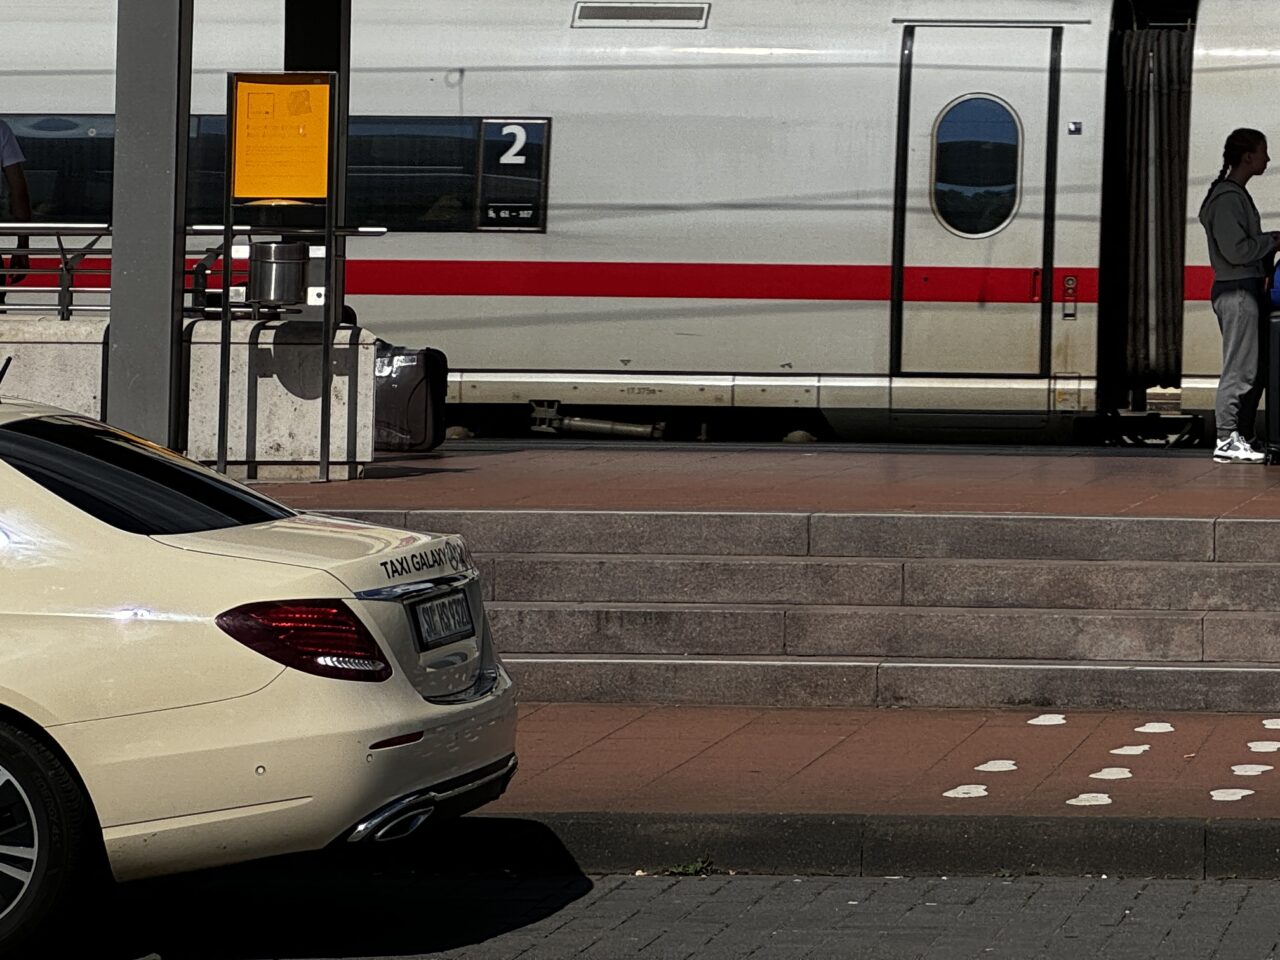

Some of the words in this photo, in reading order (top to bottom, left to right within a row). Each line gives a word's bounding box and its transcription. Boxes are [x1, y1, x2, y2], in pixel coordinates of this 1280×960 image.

[499, 124, 527, 164] 2
[380, 556, 412, 580] TAXI
[411, 547, 448, 572] GALAXY
